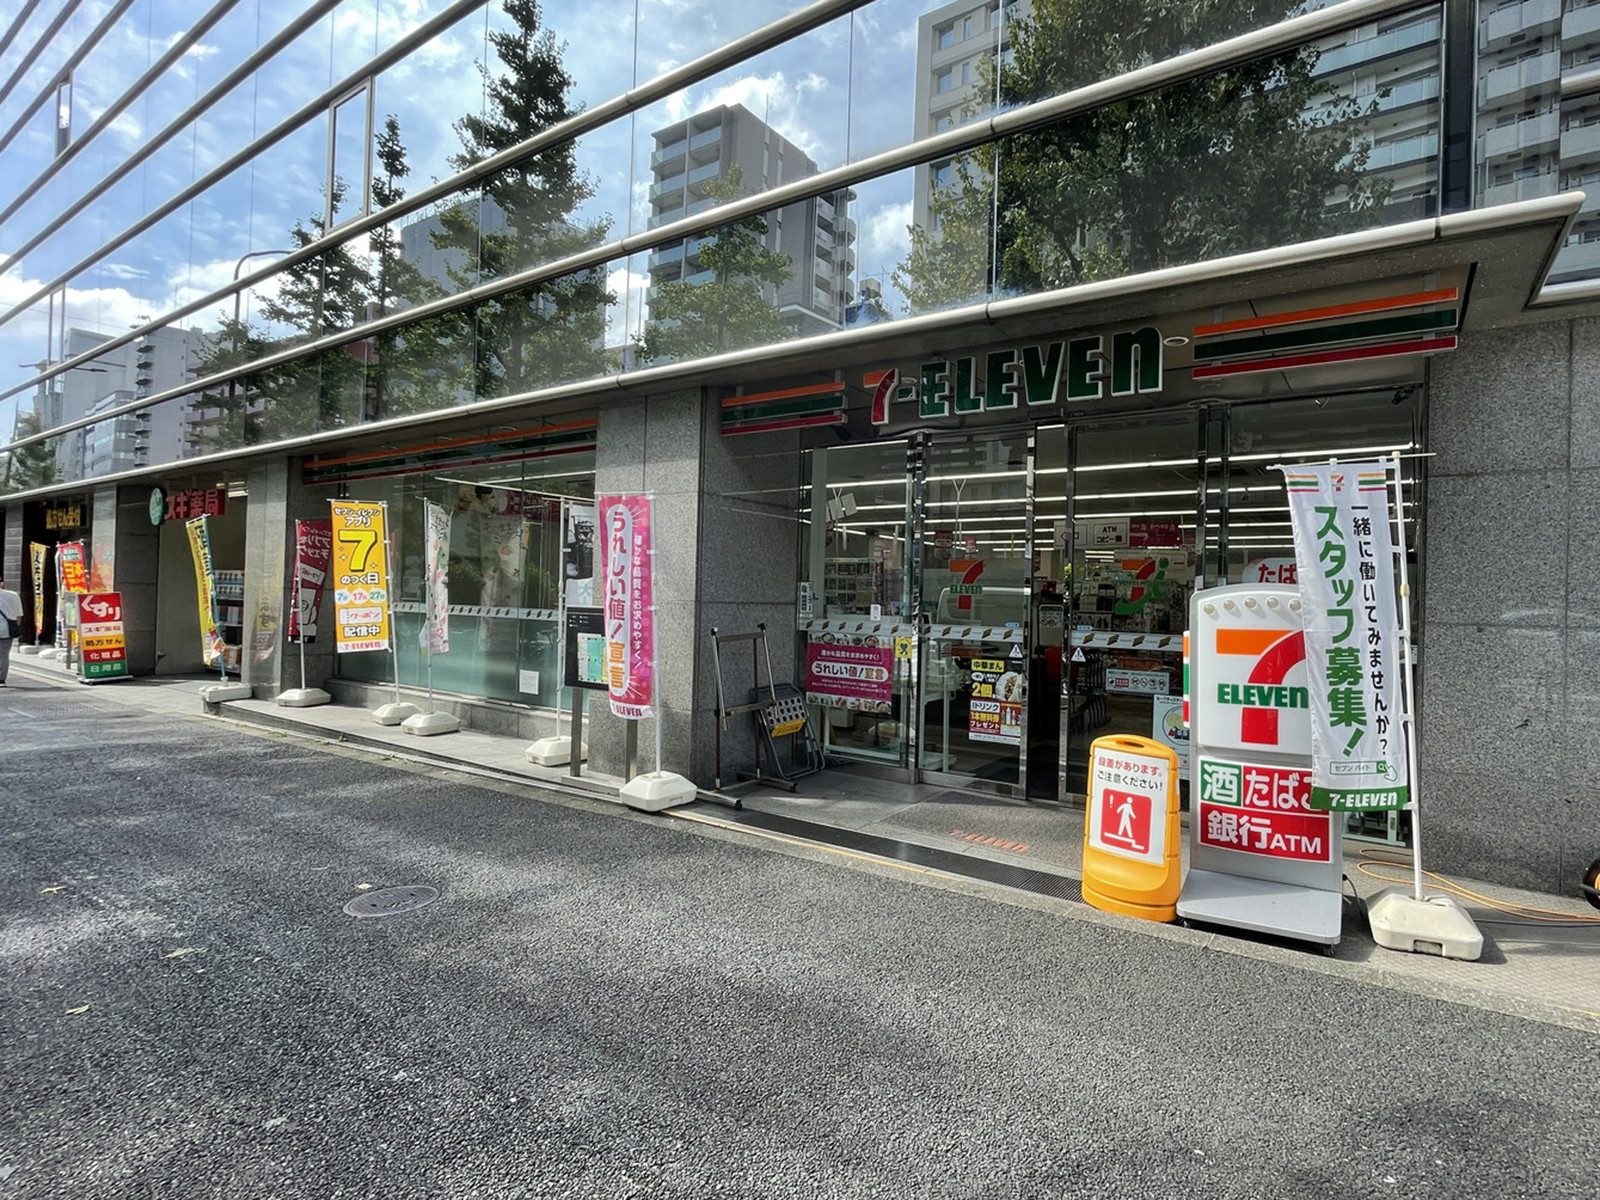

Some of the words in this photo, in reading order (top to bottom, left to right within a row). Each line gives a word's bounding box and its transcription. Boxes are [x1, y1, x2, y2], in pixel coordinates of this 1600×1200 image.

[164, 488, 218, 519] スギ薬局
[345, 515, 371, 528] アプリ
[338, 529, 377, 572] 7
[341, 572, 379, 585] のつく日
[81, 595, 120, 621] くすり
[344, 625, 381, 638] 配信中
[1313, 505, 1368, 757] スタッフ募集！
[1351, 505, 1388, 756] 一緒に働いてみませんか？
[86, 639, 122, 647] 処方せん
[90, 651, 121, 660] 化粧品
[91, 664, 121, 673] 日用品
[973, 661, 1003, 671] 中華まん
[972, 682, 993, 698] 2個
[970, 721, 1000, 730] プレゼント
[1098, 757, 1163, 777] 段差があります。
[1097, 770, 1163, 790] ご注意ください！
[1203, 763, 1239, 803] 酒
